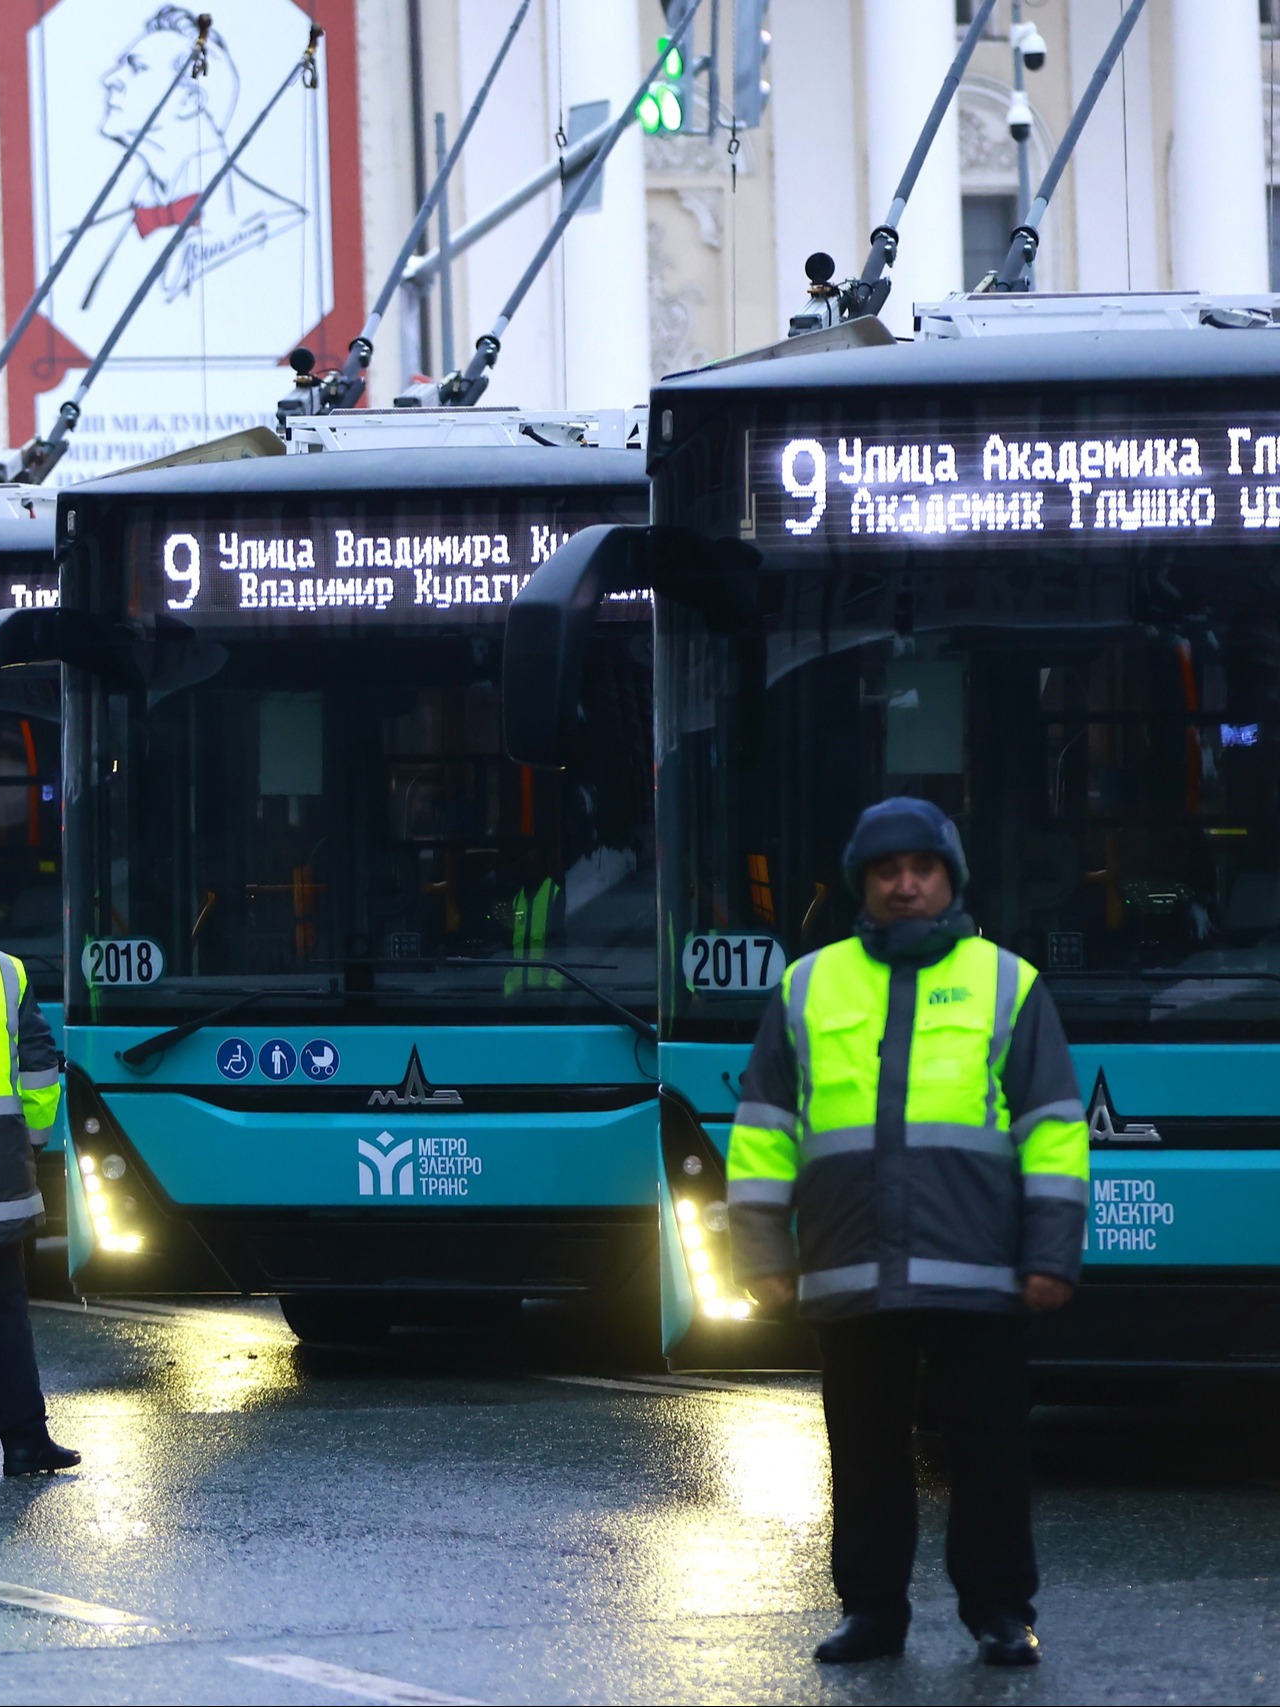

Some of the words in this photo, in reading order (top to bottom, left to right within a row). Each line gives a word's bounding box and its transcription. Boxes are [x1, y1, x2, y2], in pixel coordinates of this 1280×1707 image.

[838, 437, 959, 486] Улица
[982, 433, 1203, 484] Академика
[1227, 427, 1280, 475] Гл
[782, 438, 826, 535] 9
[850, 487, 1044, 535] Академик
[1069, 481, 1216, 531] Глушко
[219, 532, 316, 572] Улица
[335, 529, 511, 569] Владимира
[163, 533, 201, 610] 9
[239, 572, 395, 611] Владимир
[89, 942, 153, 983] 2018
[691, 937, 774, 987] 2017
[1088, 1083, 1163, 1141] АЗ
[418, 1137, 467, 1156] МЕТРО
[419, 1157, 482, 1175] ЭЛЕКТРО
[420, 1177, 469, 1196] ТРАНС
[1094, 1179, 1156, 1202] МЕТРО
[1095, 1203, 1175, 1225] ЭЛЕКТРО
[1095, 1228, 1157, 1250] ТРАНС
